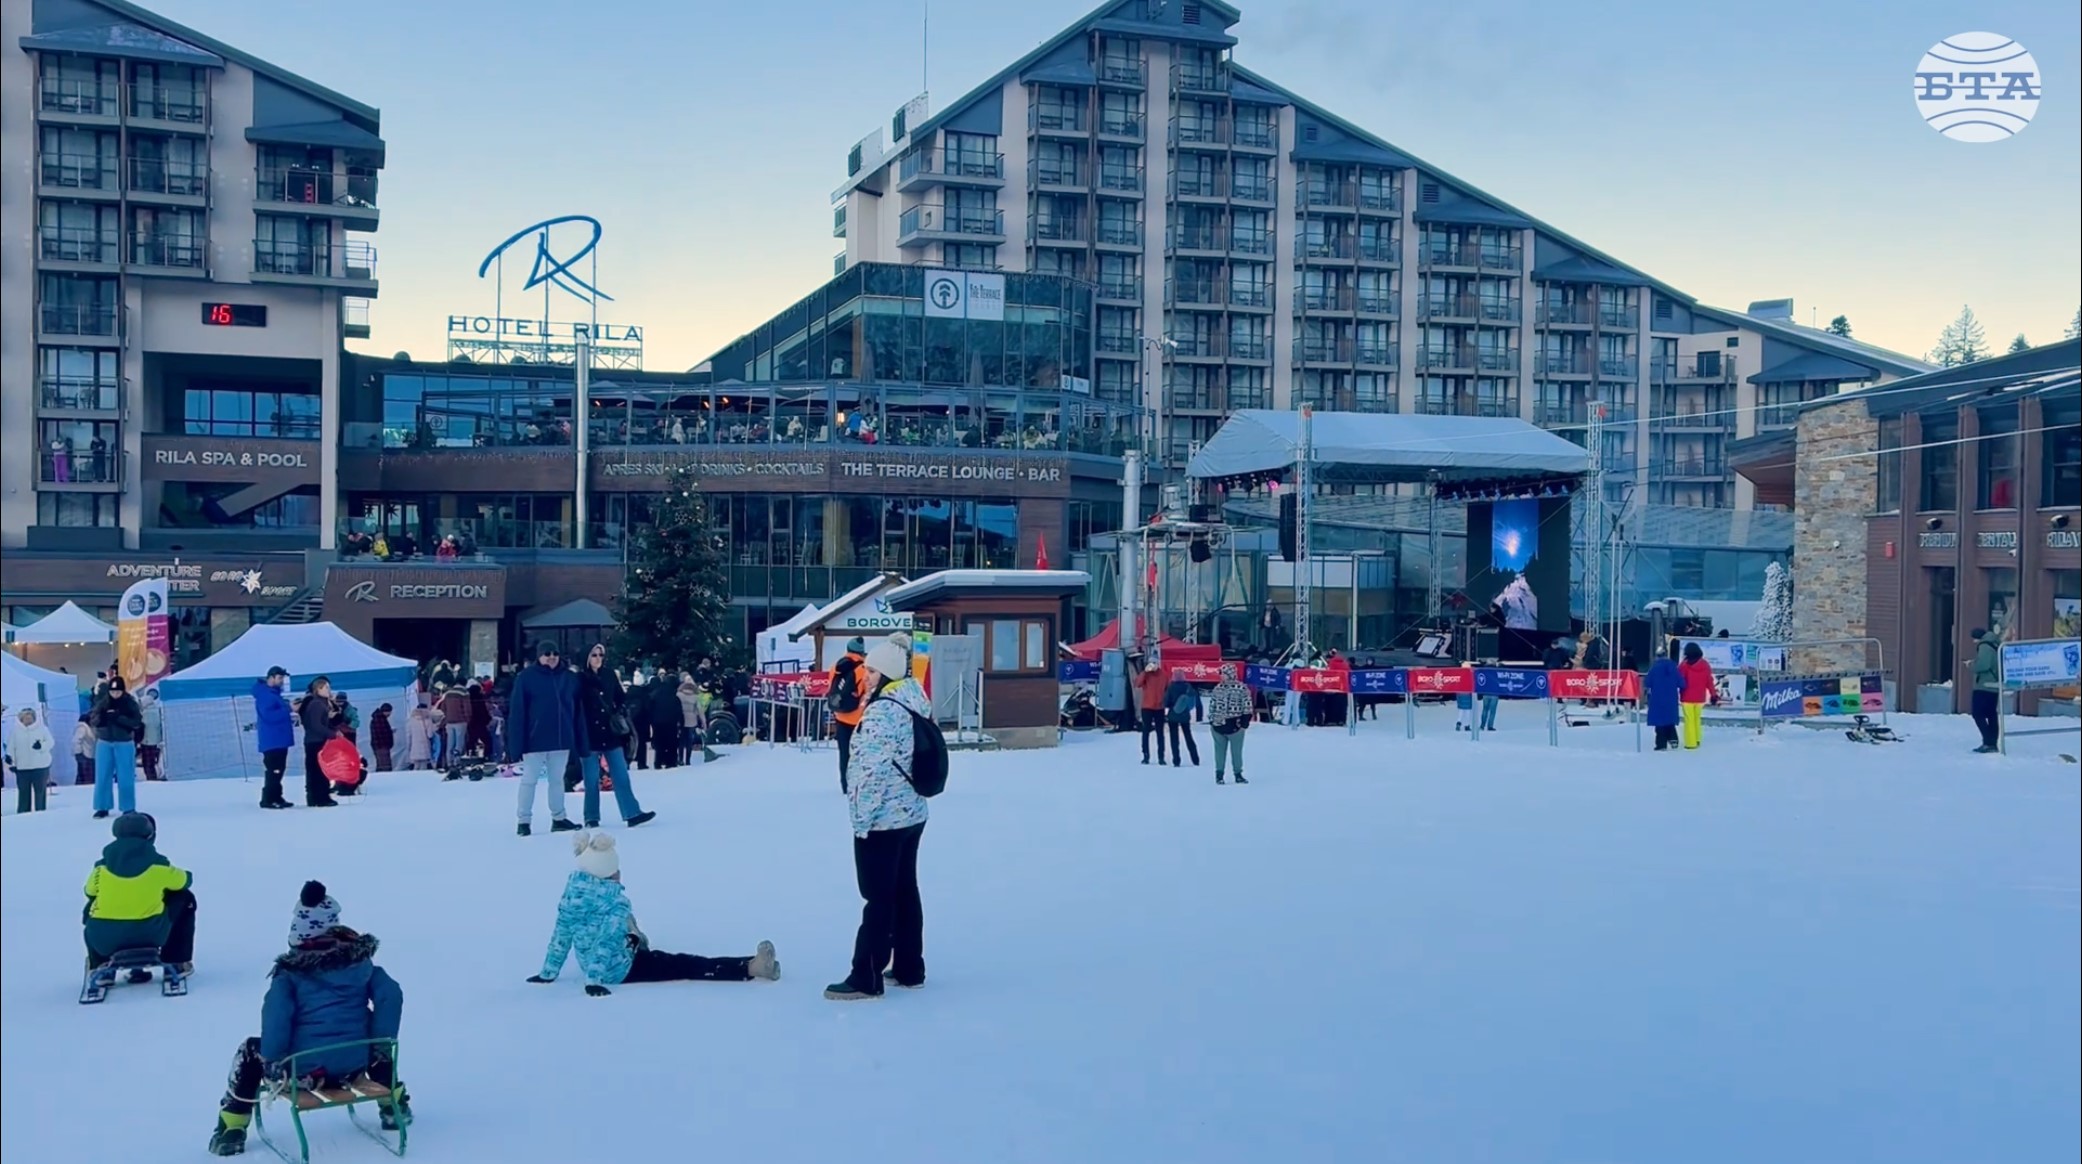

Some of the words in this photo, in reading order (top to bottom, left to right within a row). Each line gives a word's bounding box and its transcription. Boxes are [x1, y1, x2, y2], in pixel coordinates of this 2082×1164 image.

[211, 305, 231, 323] 16
[450, 315, 553, 337] HOTEL
[574, 322, 642, 342] RILA
[156, 450, 197, 464] RILA
[202, 452, 236, 466] SPA
[240, 453, 253, 466] &
[258, 454, 307, 467] POOL
[701, 464, 746, 475] DRINKS
[755, 463, 824, 475] COCKTAILS
[841, 462, 873, 477] THE
[876, 463, 948, 478] TERRACE
[952, 466, 1014, 480] LOUNGE
[1028, 468, 1060, 481] BAR
[107, 565, 202, 577] ADVENTURE
[390, 585, 487, 599] RECEPTION
[847, 618, 911, 628] BOROVE
[1566, 678, 1586, 686] BORO
[1762, 687, 1803, 710] Milka
